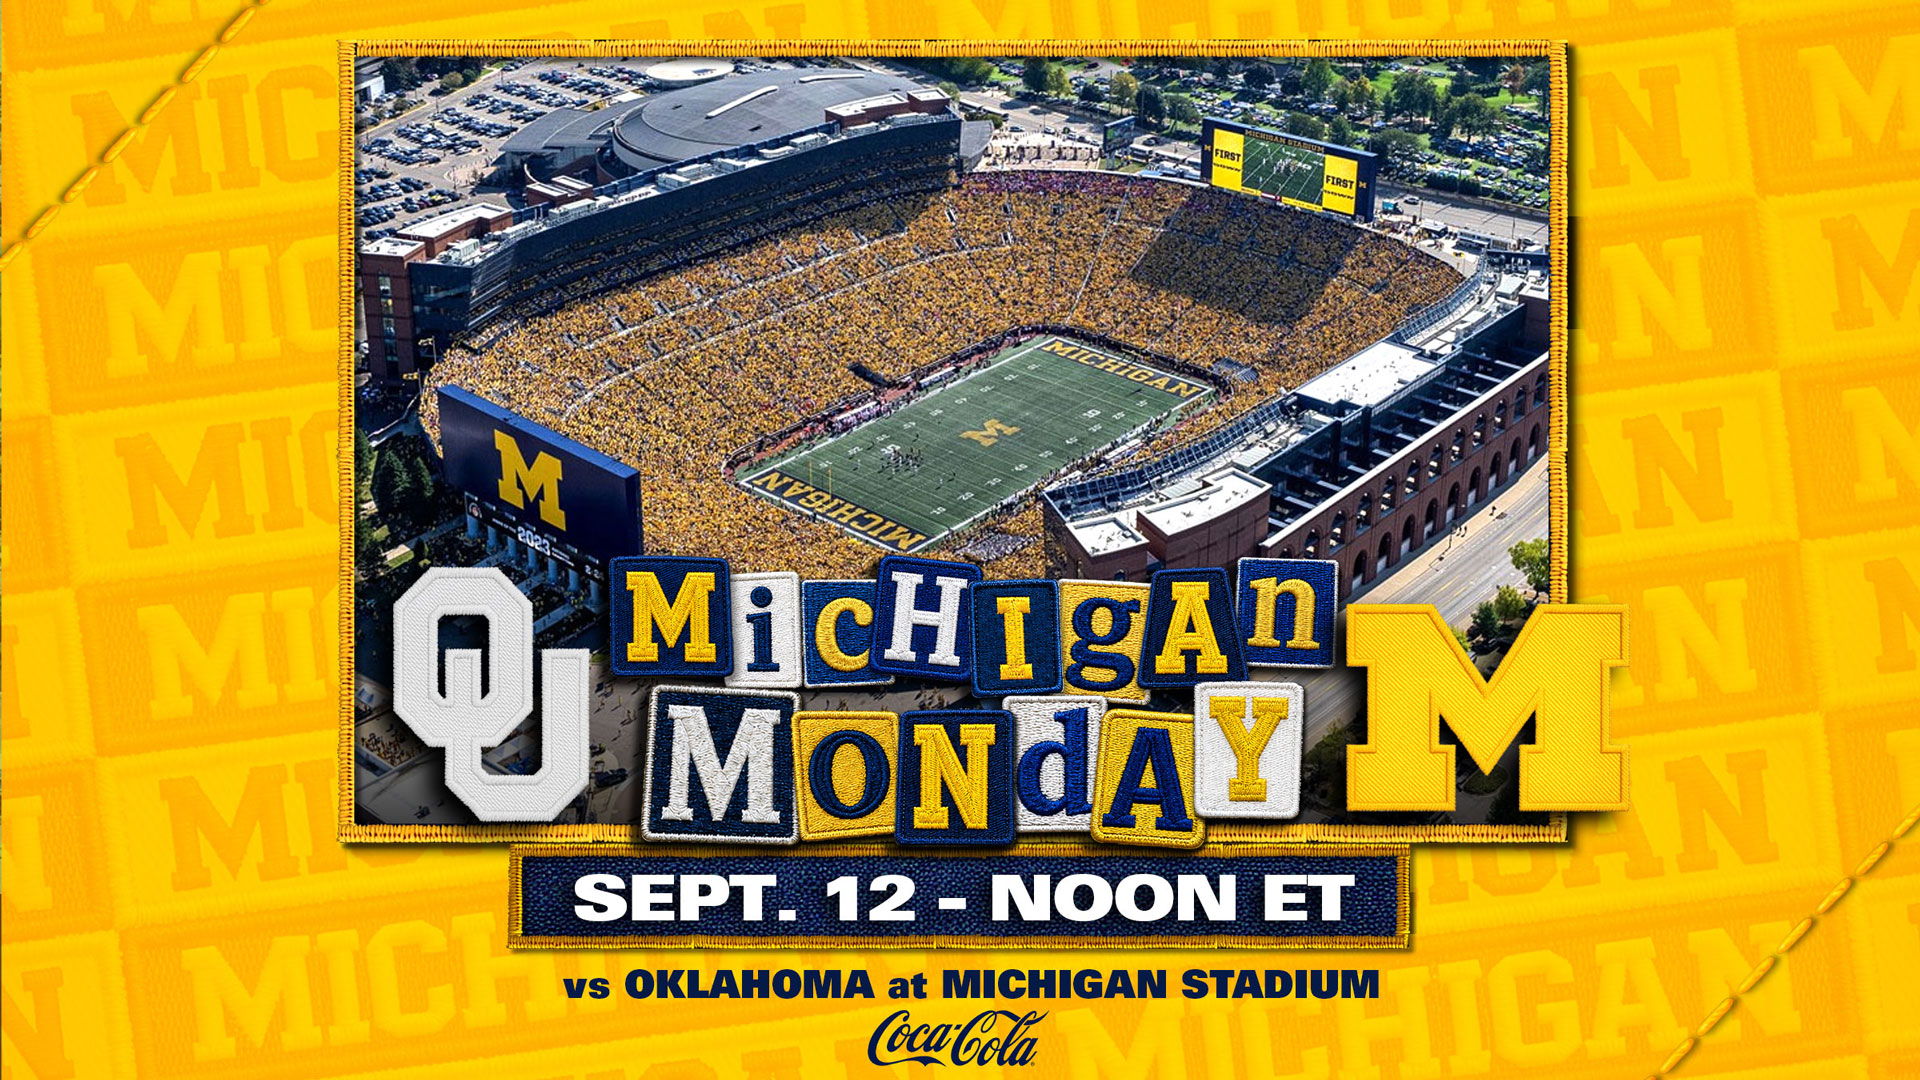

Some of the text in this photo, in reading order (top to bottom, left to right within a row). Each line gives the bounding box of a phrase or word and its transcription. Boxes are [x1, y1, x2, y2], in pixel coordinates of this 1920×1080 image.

[1214, 148, 1241, 162] FIRST
[1245, 129, 1325, 153] MICHIGAN STADIUM
[1325, 174, 1354, 190] FIRST
[1043, 341, 1203, 398] MICHIGAN
[960, 418, 1021, 447] M
[494, 429, 566, 531] M
[752, 472, 927, 550] MICHIGAN
[517, 526, 550, 556] 2023
